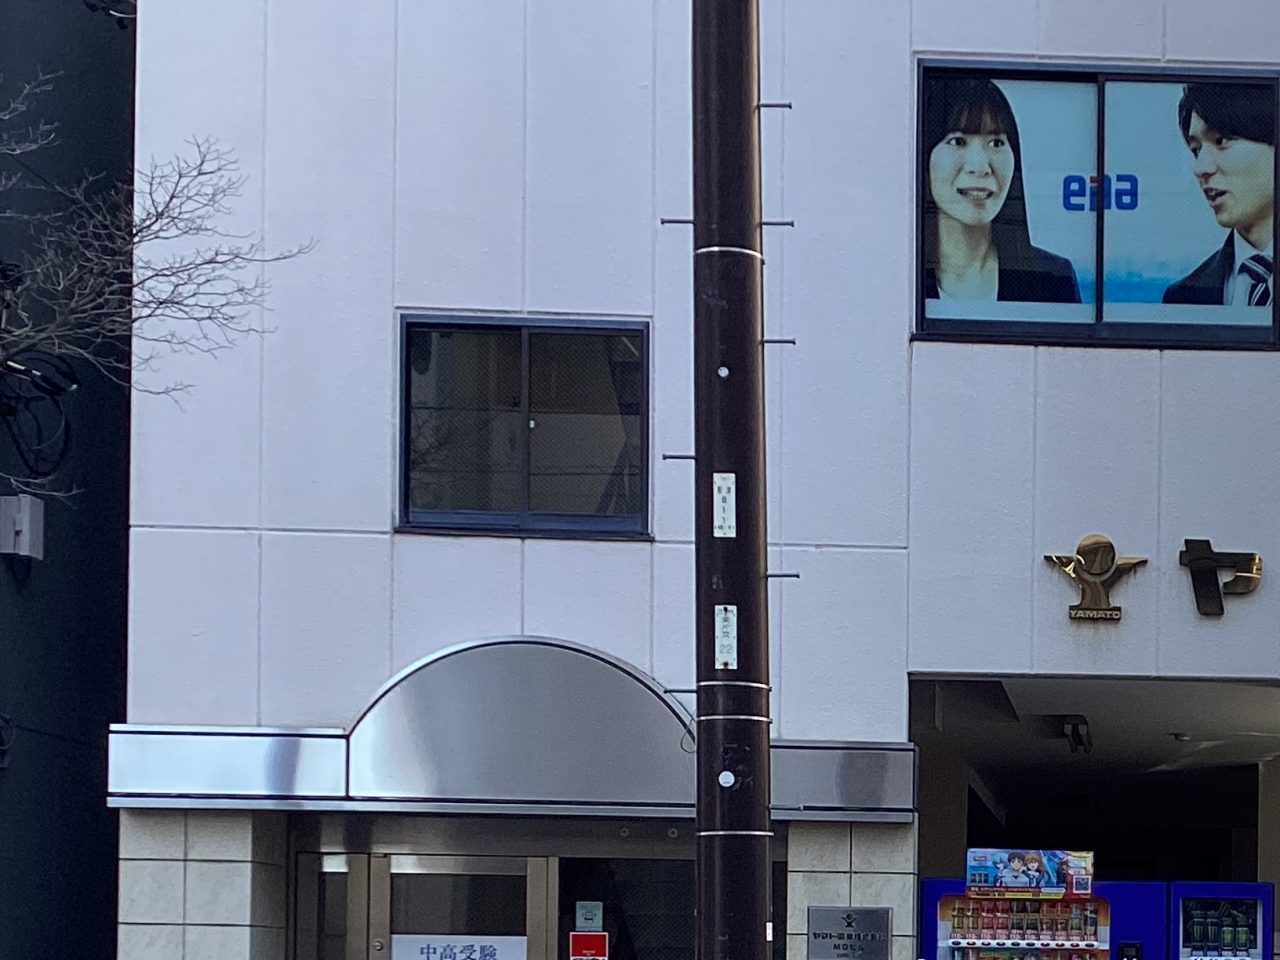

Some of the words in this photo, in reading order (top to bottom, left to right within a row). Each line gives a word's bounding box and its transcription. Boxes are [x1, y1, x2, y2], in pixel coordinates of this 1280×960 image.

[1070, 610, 1121, 619] YAMATO
[420, 943, 498, 960] 中高受験
